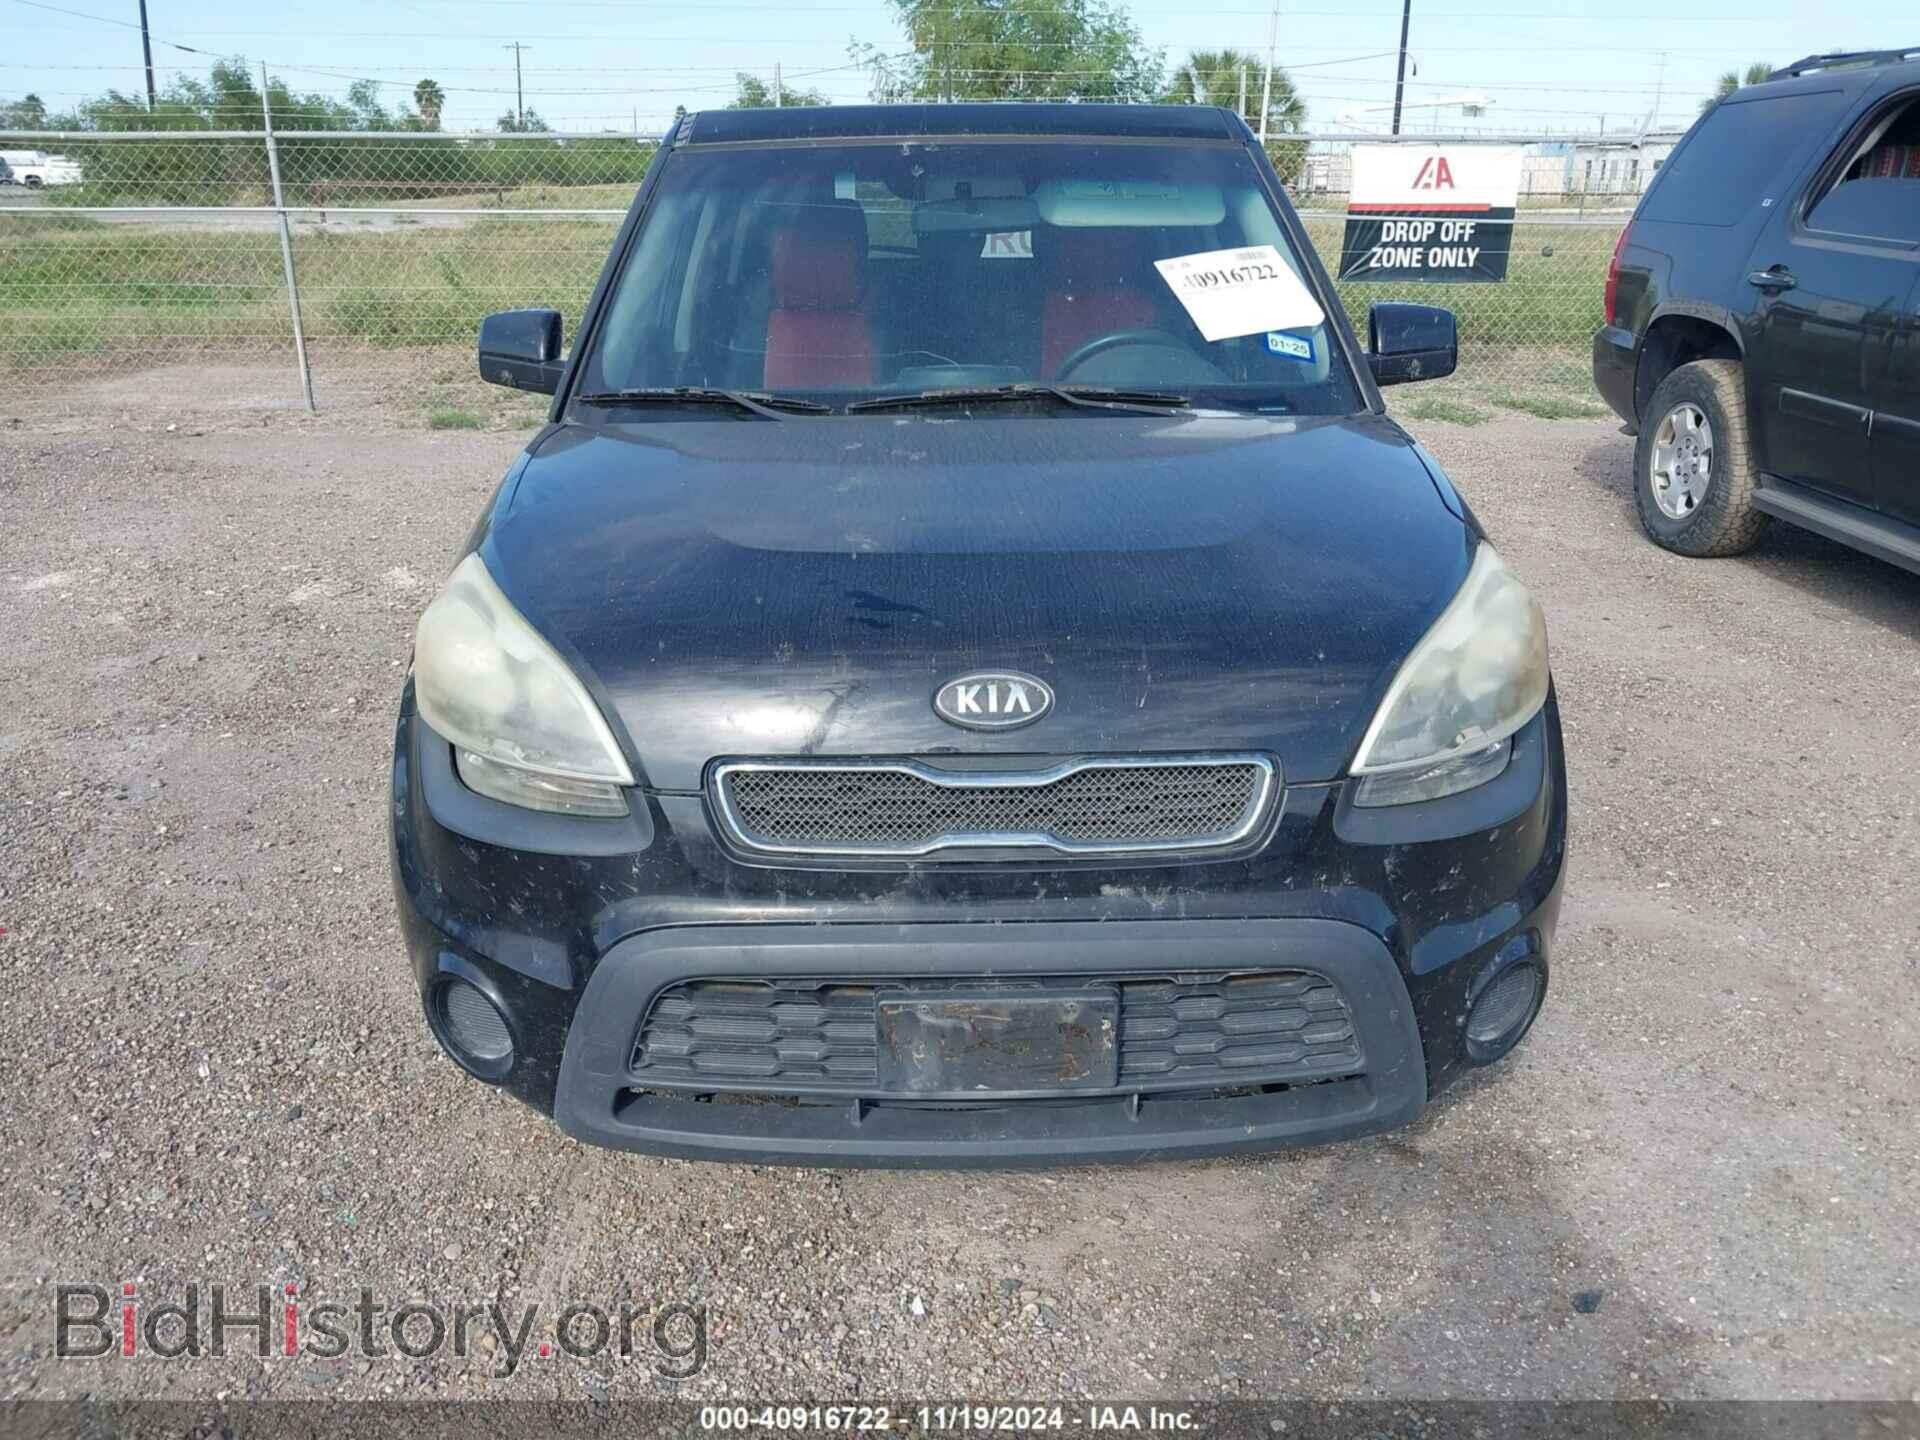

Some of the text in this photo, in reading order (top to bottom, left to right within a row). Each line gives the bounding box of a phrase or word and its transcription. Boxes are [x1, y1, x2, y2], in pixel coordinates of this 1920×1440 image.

[1381, 221, 1477, 243] DROP OFF
[1368, 247, 1481, 269] ZONE ONLY
[955, 683, 1032, 714] KIA
